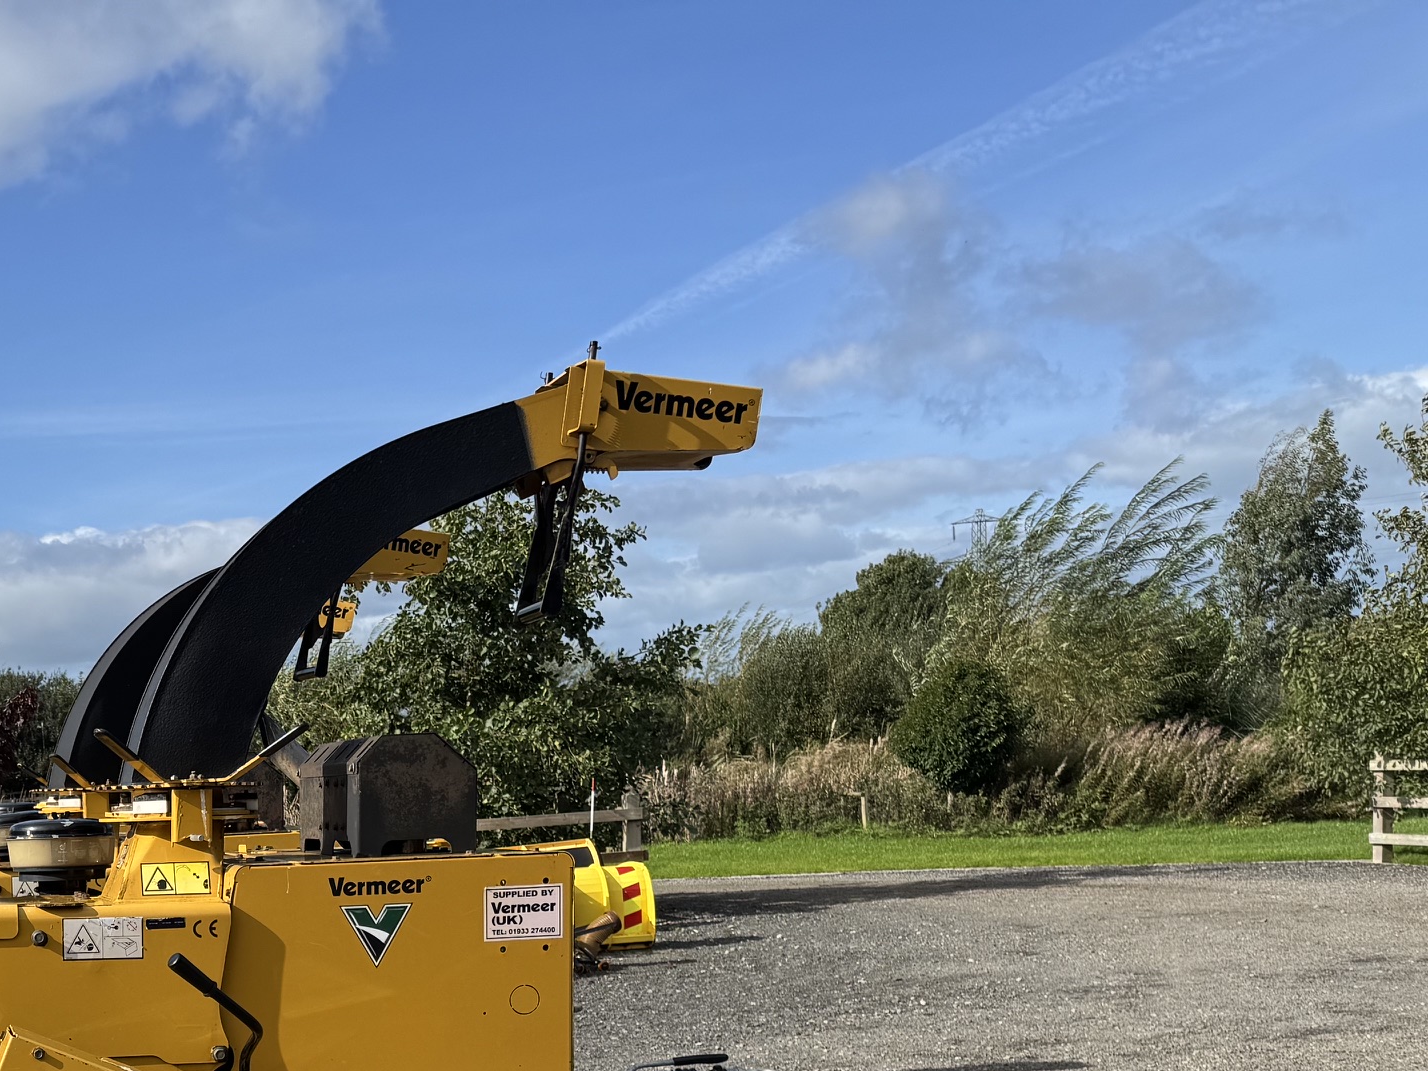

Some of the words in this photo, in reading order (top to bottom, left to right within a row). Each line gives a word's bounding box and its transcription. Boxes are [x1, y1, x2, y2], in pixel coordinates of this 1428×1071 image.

[493, 890, 538, 899] SUPPLIED
[491, 902, 556, 914] Vermeer
[492, 914, 523, 926] (UK)
[531, 926, 556, 934] 274400
